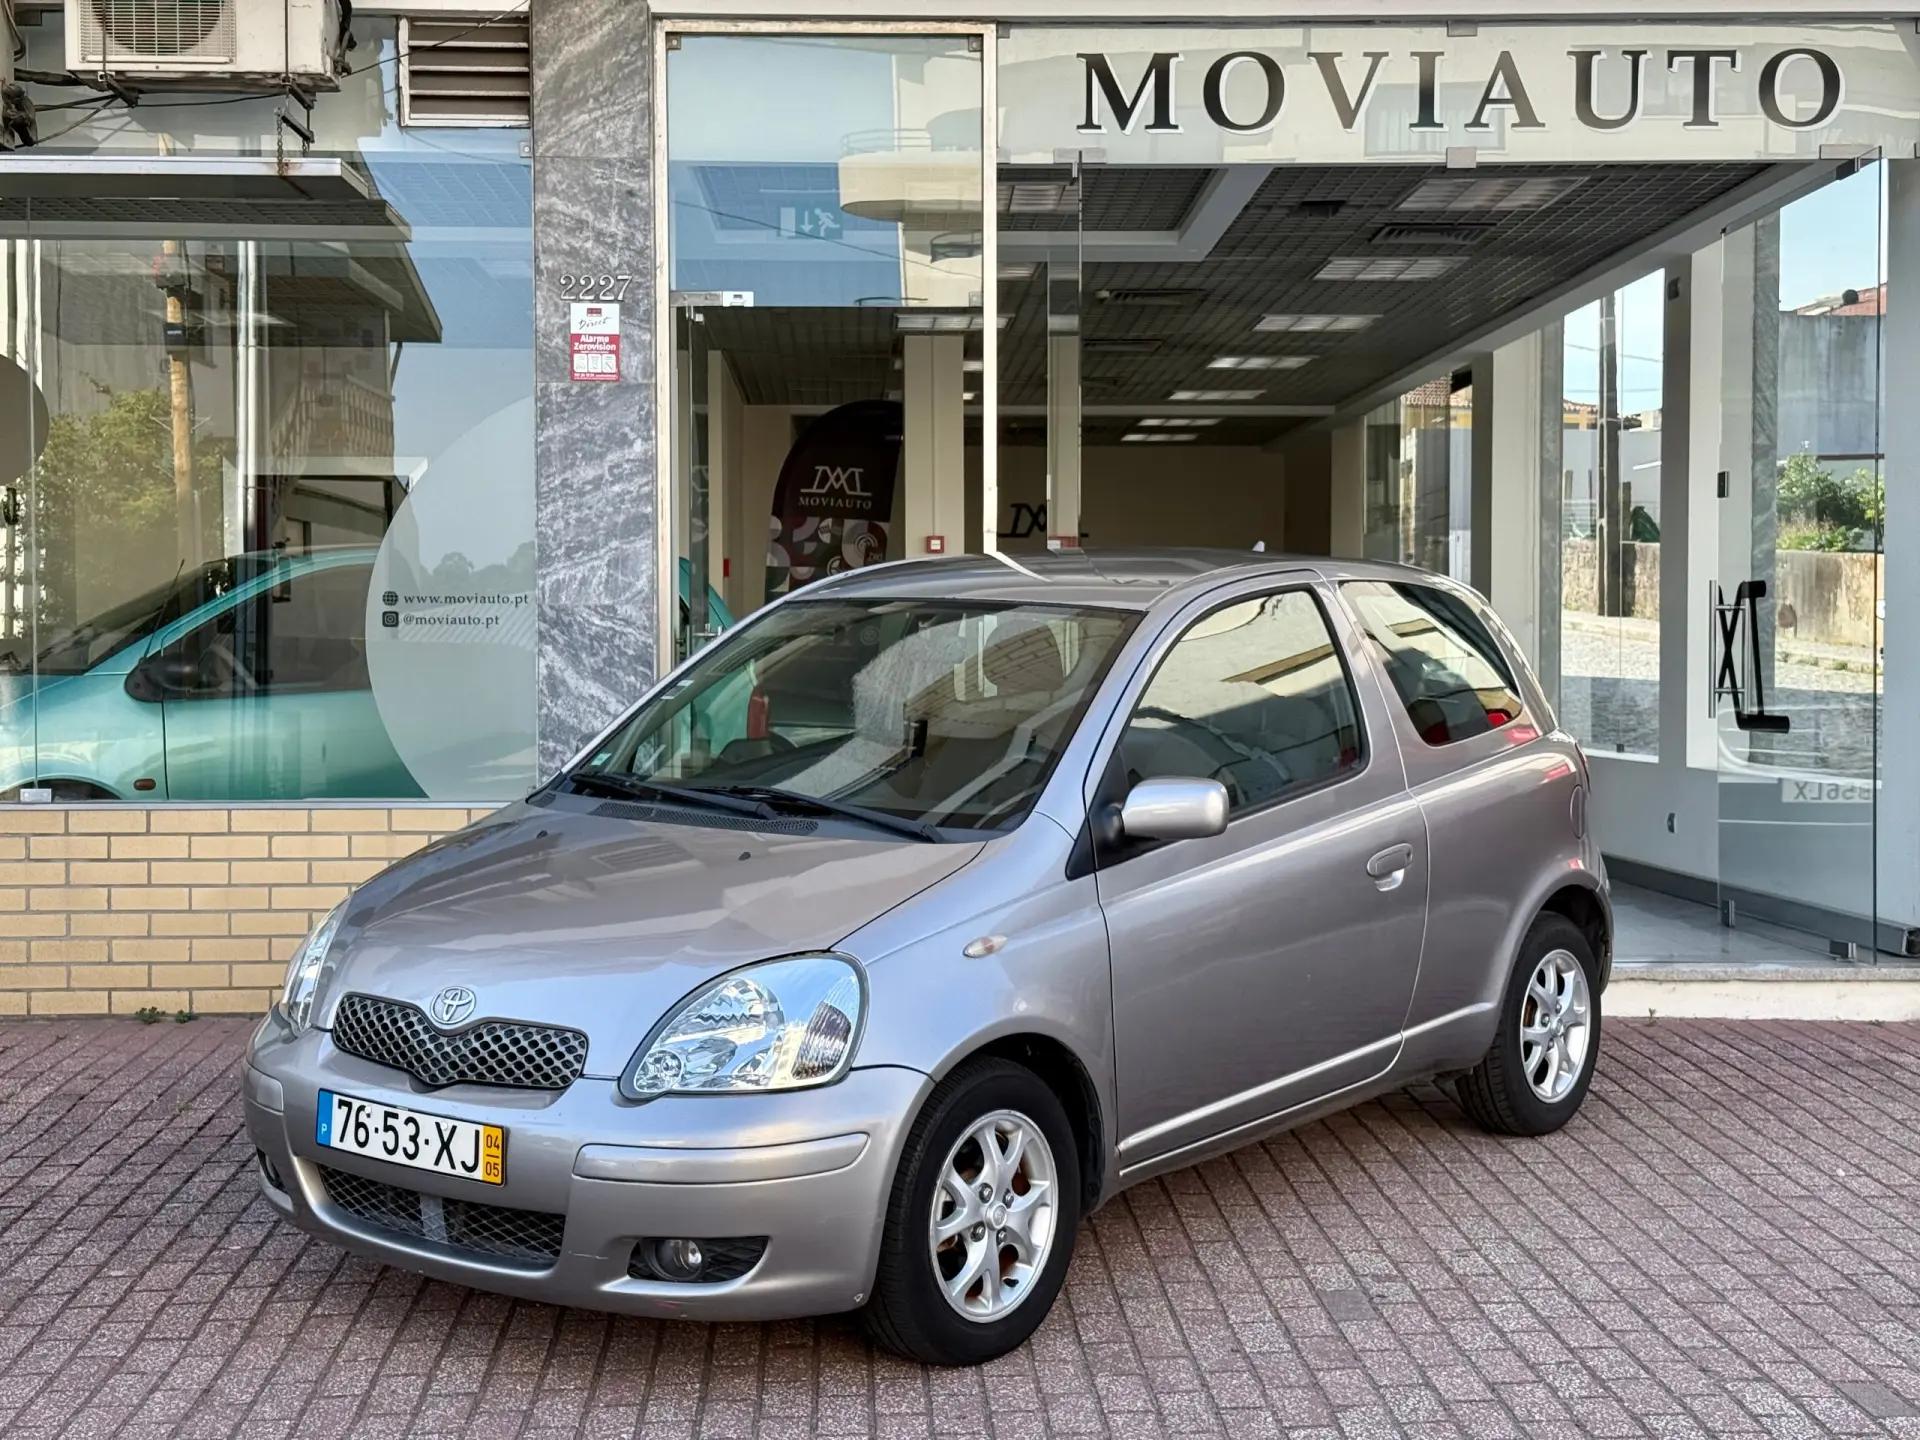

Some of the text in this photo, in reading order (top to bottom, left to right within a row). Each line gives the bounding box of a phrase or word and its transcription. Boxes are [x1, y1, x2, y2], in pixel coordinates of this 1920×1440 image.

[1076, 47, 1846, 136] MOVIAUTO
[560, 274, 633, 301] 2227
[580, 334, 610, 344] Alarme
[798, 495, 873, 510] MOVIAUTO
[403, 592, 529, 608] www.moviauto.pt
[402, 613, 500, 629] @moviauto.pt
[321, 1123, 328, 1135] P
[485, 1134, 500, 1151] 04
[485, 1161, 500, 1178] 05
